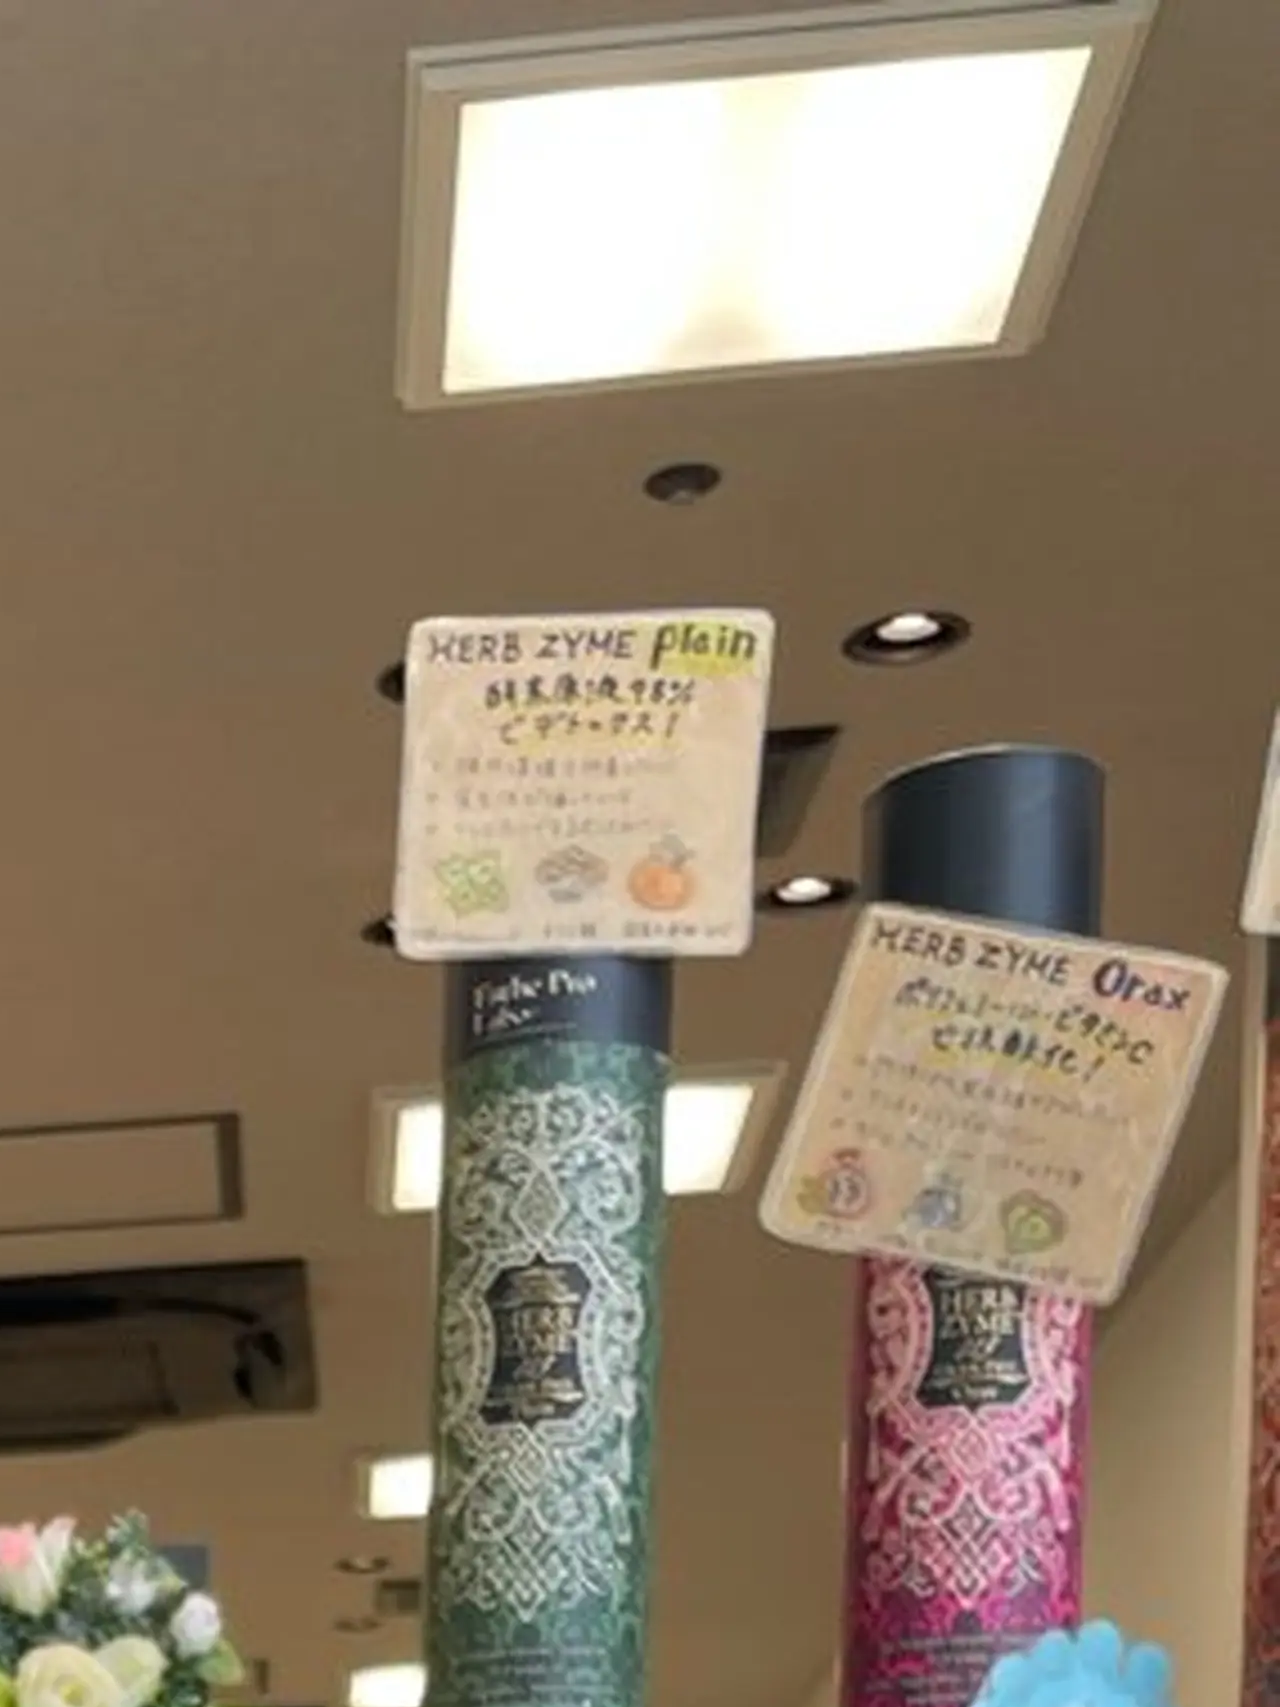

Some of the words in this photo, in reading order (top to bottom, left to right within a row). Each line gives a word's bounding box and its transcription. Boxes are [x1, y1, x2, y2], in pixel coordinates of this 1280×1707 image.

[427, 631, 521, 664] HERB
[535, 628, 636, 661] ZYME
[649, 621, 758, 670] plain
[872, 920, 967, 967] HERB
[974, 938, 1072, 987] ZYME
